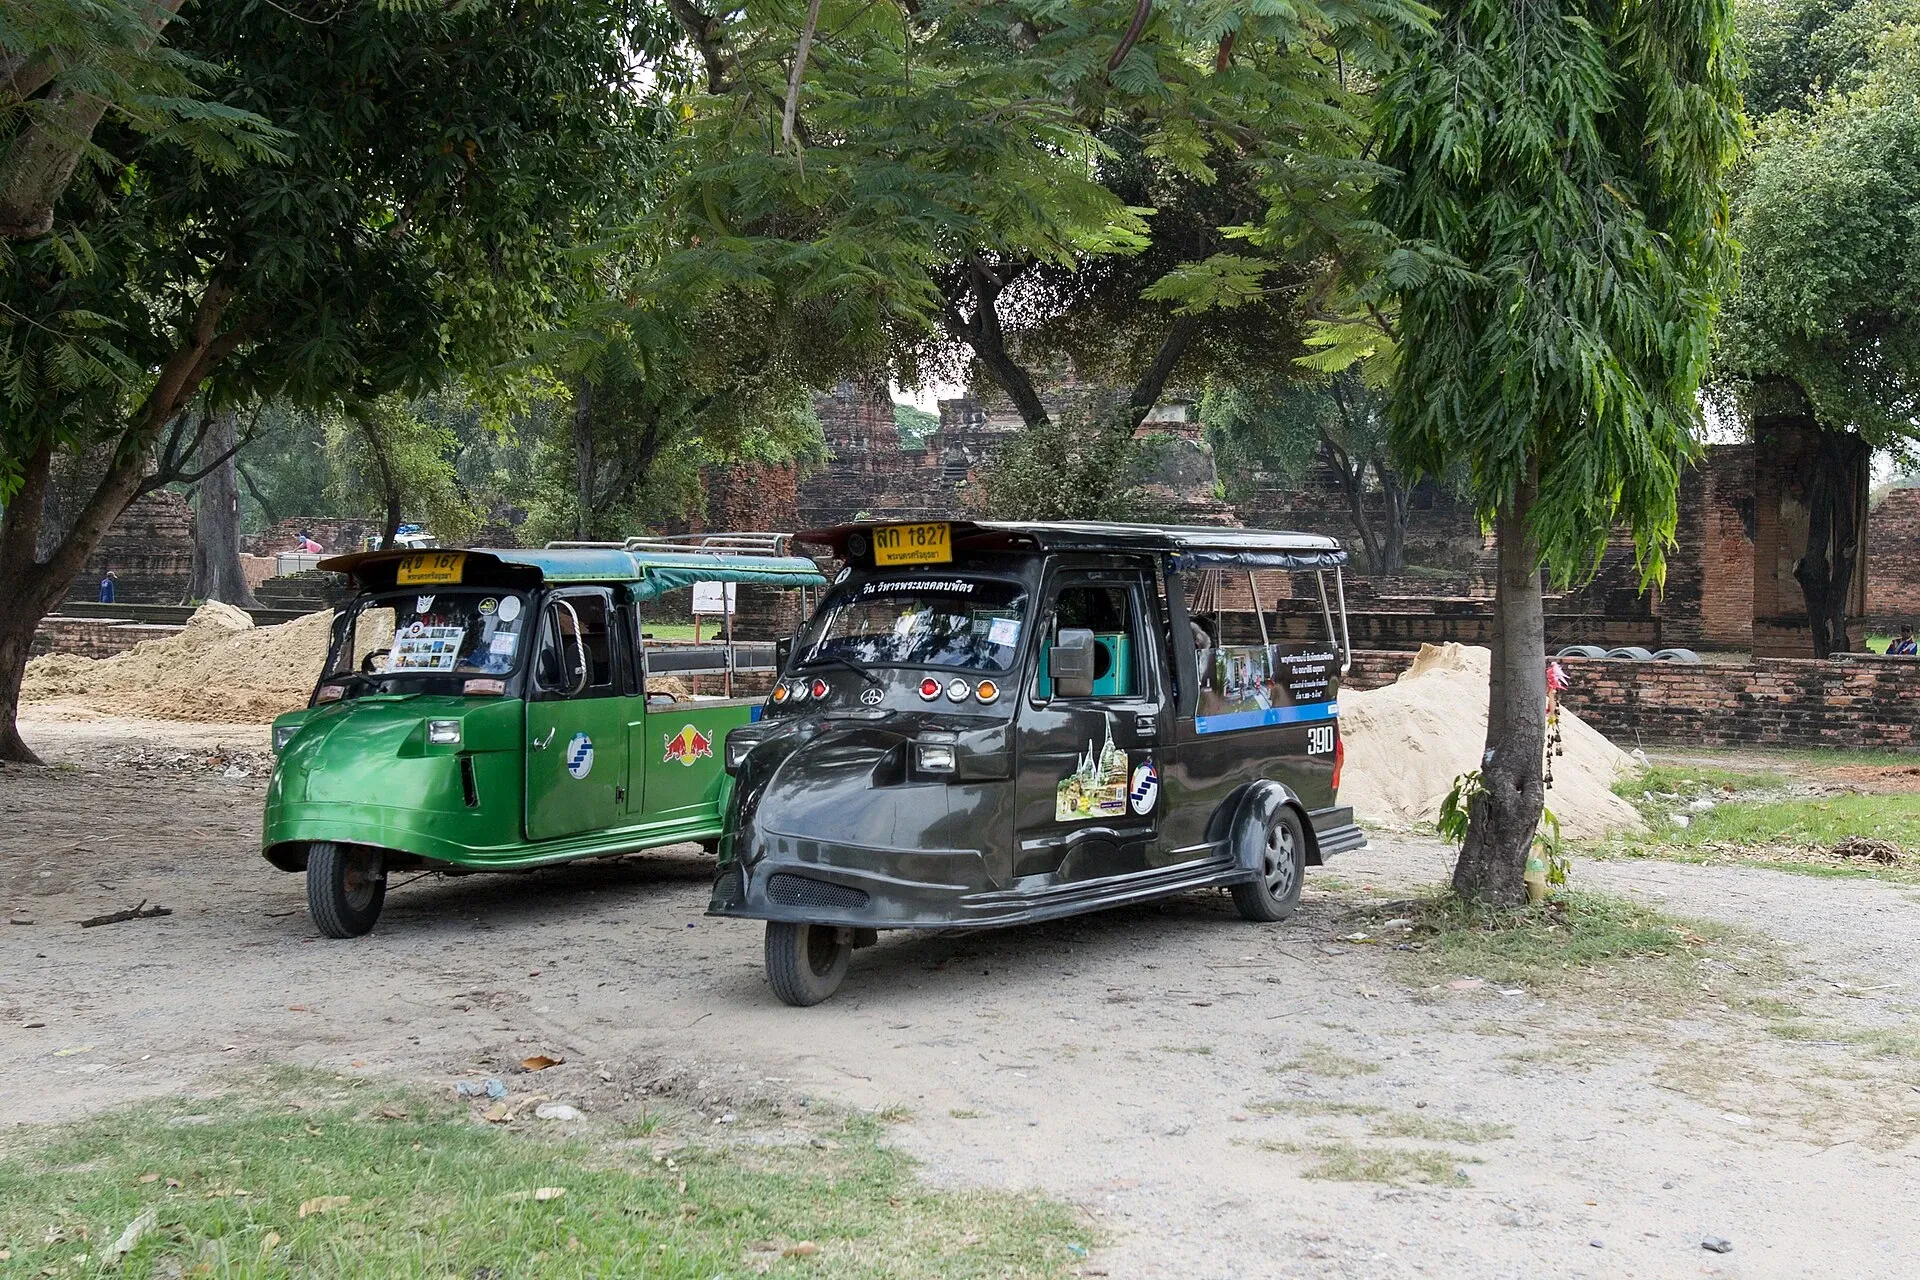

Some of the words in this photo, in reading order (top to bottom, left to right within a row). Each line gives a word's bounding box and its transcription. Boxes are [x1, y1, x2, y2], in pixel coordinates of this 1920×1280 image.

[908, 524, 946, 546] 1827
[434, 553, 460, 570] 167
[886, 550, 939, 561] พระนครศรีอยุธยา
[878, 579, 974, 593] วิหารพระมงคลบพิตร
[1307, 726, 1334, 755] 390
